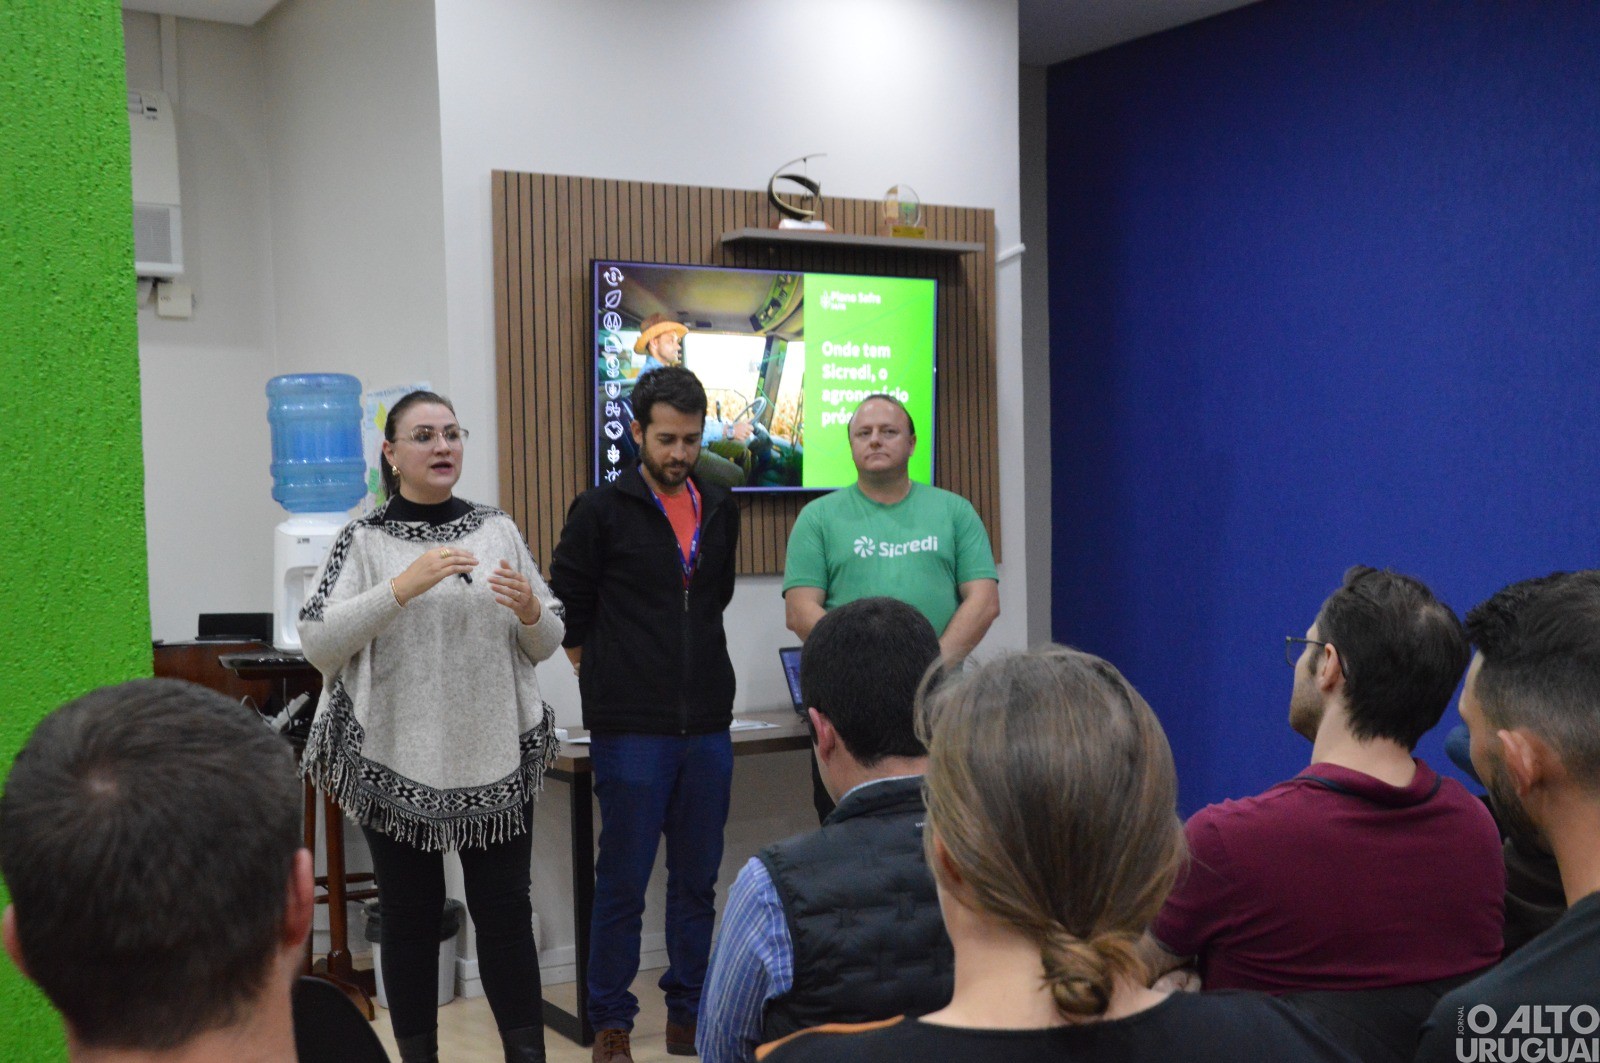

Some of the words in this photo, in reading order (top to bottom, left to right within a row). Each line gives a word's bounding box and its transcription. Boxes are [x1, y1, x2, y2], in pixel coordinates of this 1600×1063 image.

[822, 341, 860, 358] Onde
[863, 343, 891, 358] tem
[822, 363, 876, 383] Sicredi,
[878, 368, 888, 380] o
[878, 535, 938, 558] Sicredi
